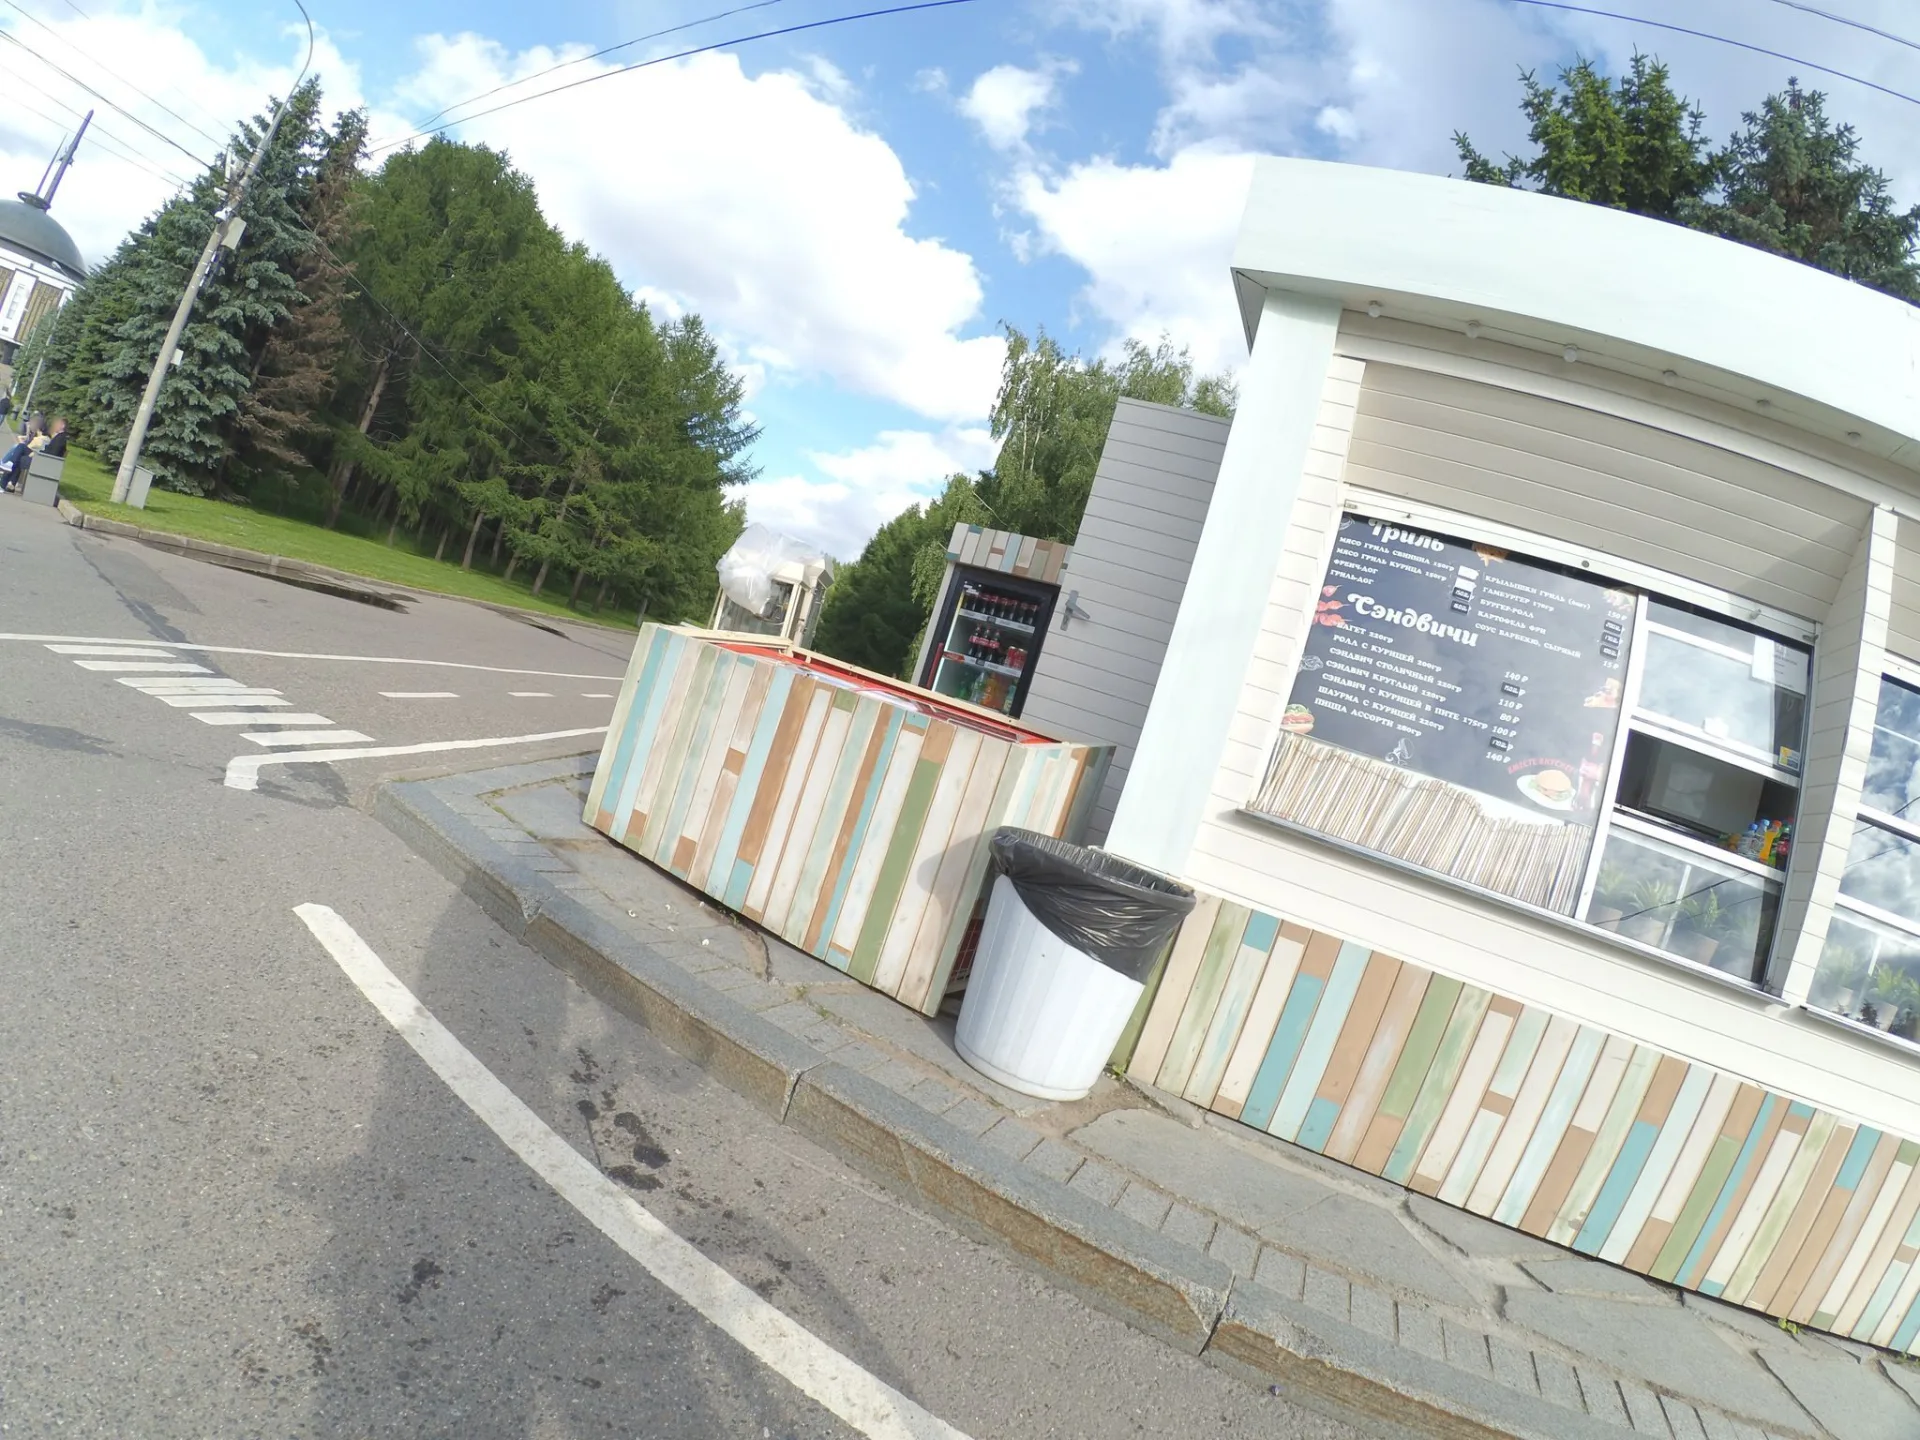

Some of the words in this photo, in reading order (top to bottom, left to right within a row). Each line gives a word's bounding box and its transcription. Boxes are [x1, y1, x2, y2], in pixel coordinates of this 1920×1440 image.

[1336, 547, 1359, 558] МЯСО
[1361, 553, 1387, 565] ГРИЛЬ
[1389, 561, 1423, 575] КУРИЦА
[1340, 536, 1362, 547] МЯСО
[1364, 542, 1390, 554] ГРИЛЬ
[1392, 550, 1431, 565] СВИНИНА
[1330, 569, 1375, 585] ГРИЛЬ-ДОГ
[1333, 559, 1379, 574] ФРЕНЧ-ДОГ
[1482, 587, 1531, 604] ГАМБУРГЕР
[1485, 575, 1537, 594] КРЫЛЫШКИ
[1539, 590, 1565, 603] ГРИЛЬ
[1347, 593, 1480, 647] Сэндвичи
[1477, 610, 1526, 629] КАРТОФЕЛЬ
[1529, 625, 1547, 635] ФРИ
[1480, 599, 1535, 619] БУРГЕР-РОЛЛ
[1333, 634, 1359, 647] РОЛЛ
[1371, 645, 1415, 663] КУРИЦЕЙ
[1417, 660, 1442, 672] 200гр
[1475, 623, 1497, 634] СОУС
[1543, 642, 1582, 659] СЫРНЫЙ
[1326, 660, 1370, 678] СЭНДВИЧ
[1372, 673, 1419, 693] КРУГЛЫЙ
[1329, 647, 1373, 665] СЭНДВИЧ
[1376, 660, 1434, 684] СТОЛИЧНЫЙ
[1504, 671, 1521, 681] 140
[1314, 697, 1348, 714] ПИЦЦА
[1350, 709, 1395, 728] АССОРТИ
[1318, 686, 1360, 704] ШАУРМА
[1372, 703, 1416, 722] КУРИЦЕЙ
[1419, 718, 1445, 732] 220гр
[1322, 673, 1367, 691] СЭНДВИЧ
[1378, 690, 1423, 709] КУРИЦЕЙ
[1435, 707, 1460, 721] ПИТЕ
[1462, 717, 1489, 730] 175гр
[1498, 699, 1515, 709] 110
[1491, 726, 1509, 736] 100
[1485, 751, 1503, 762] 140
